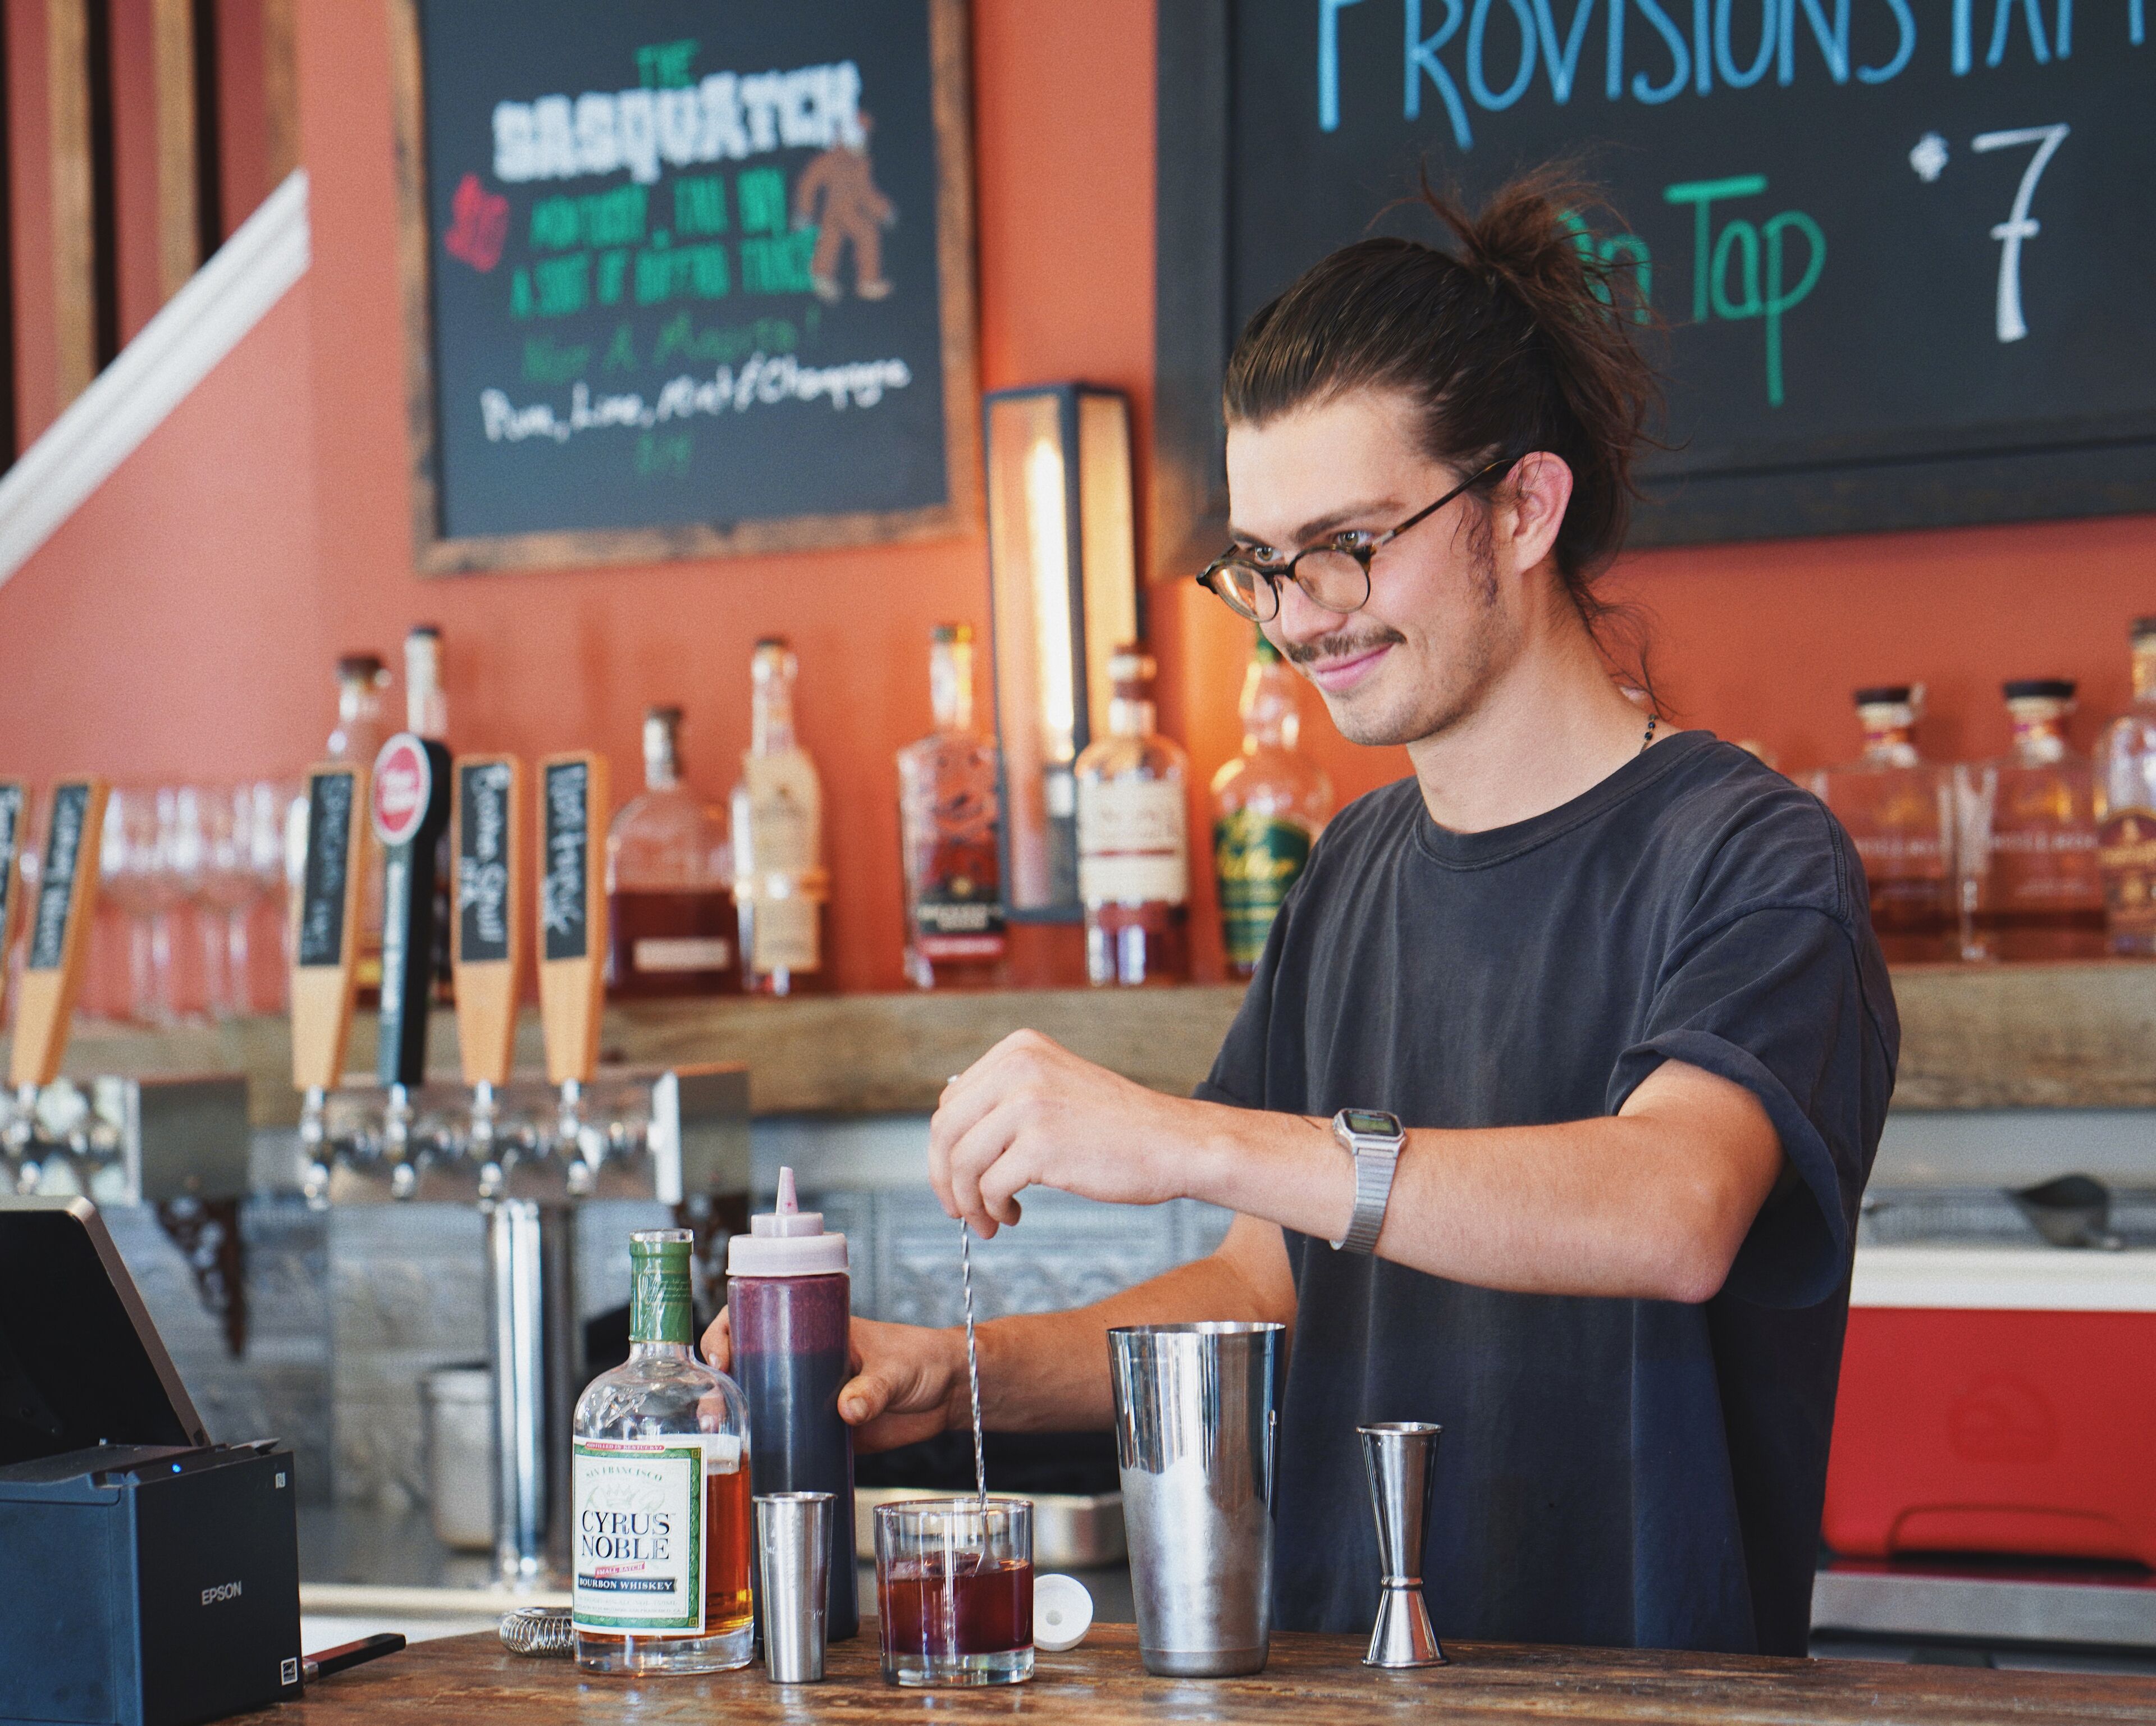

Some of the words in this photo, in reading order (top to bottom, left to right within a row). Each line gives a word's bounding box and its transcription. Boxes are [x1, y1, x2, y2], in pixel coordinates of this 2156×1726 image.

[492, 60, 865, 185] SASQUATCH
[1662, 173, 1828, 408] Tap
[582, 1510, 670, 1535] CYRUS
[582, 1535, 670, 1559] NOBLE
[202, 1581, 241, 1606] EPSON
[579, 1577, 618, 1589] BOURBON
[620, 1581, 673, 1591] WHISKEY
